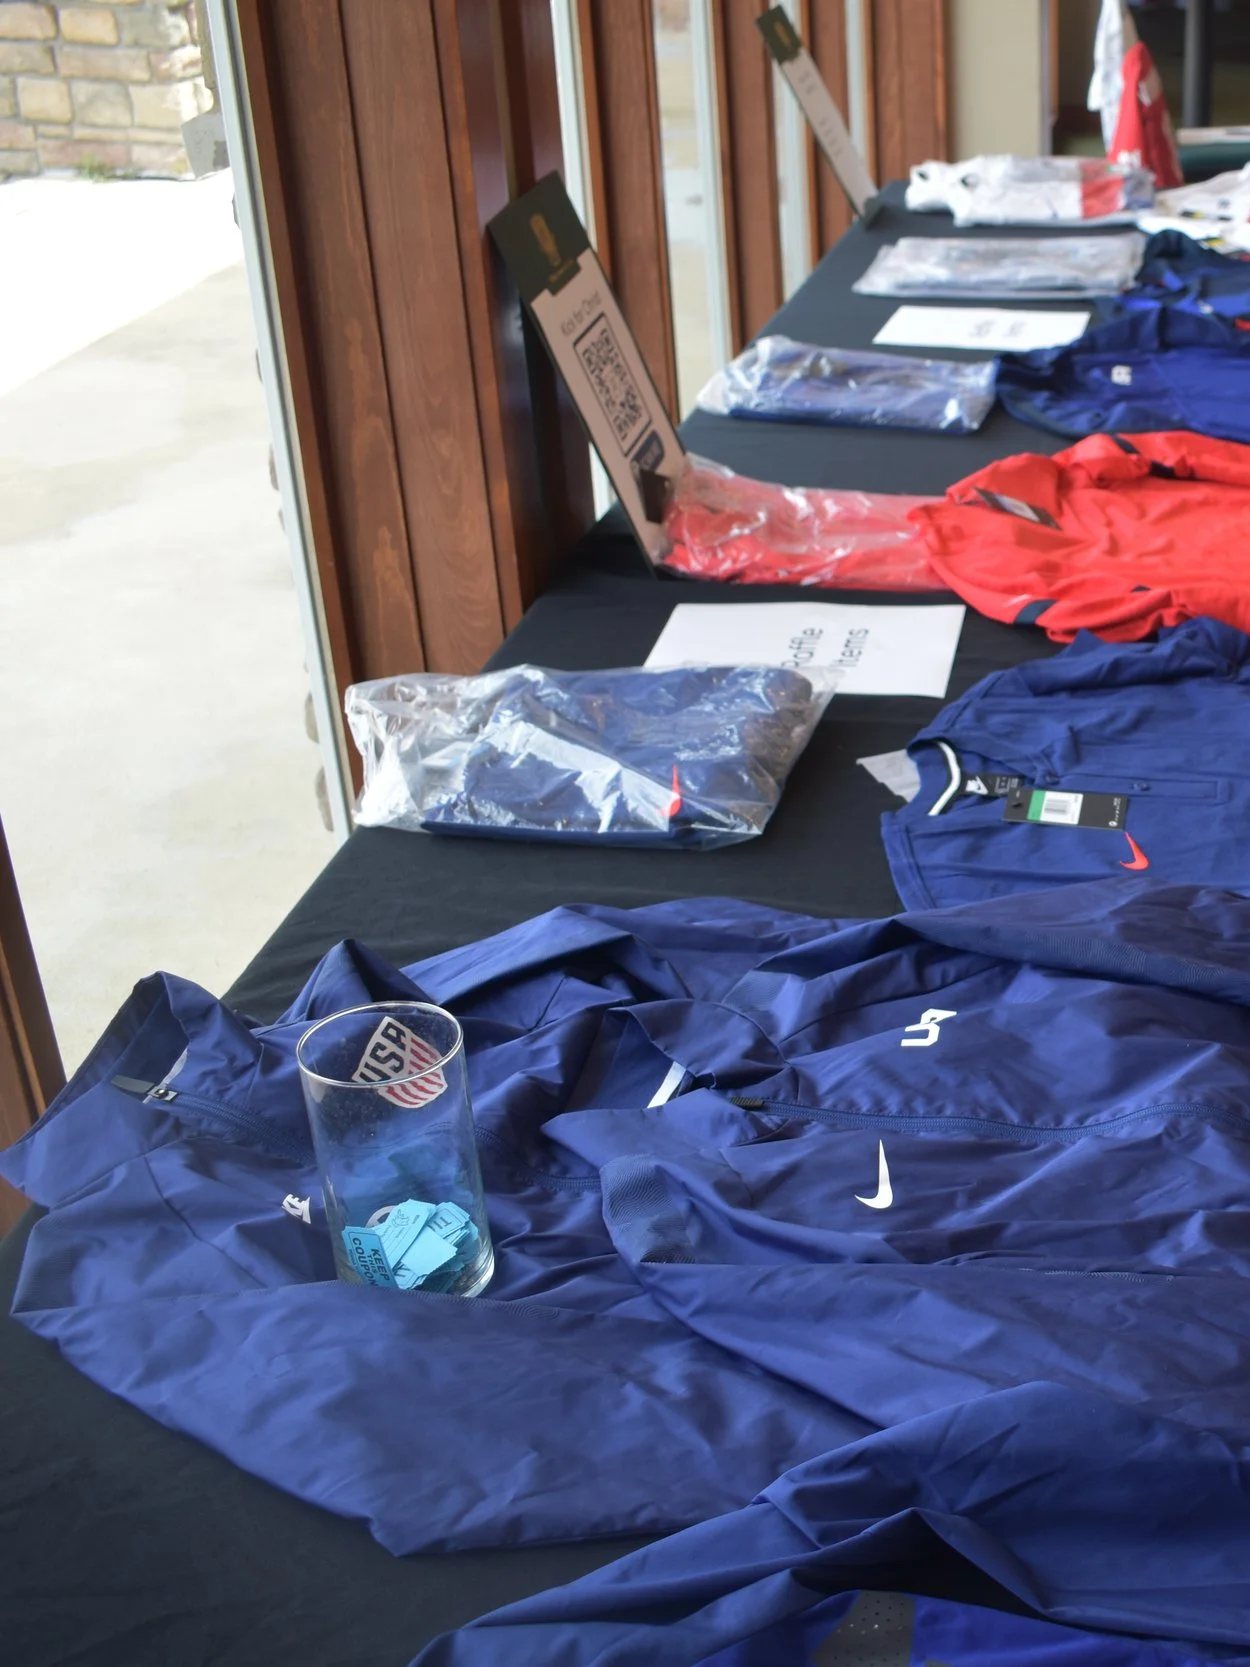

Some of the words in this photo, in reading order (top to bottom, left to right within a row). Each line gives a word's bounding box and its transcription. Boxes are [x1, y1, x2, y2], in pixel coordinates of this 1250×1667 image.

[780, 627, 824, 668] Raffle
[829, 627, 870, 668] Items
[359, 1021, 406, 1082] USA
[352, 1237, 379, 1287] COUPON
[366, 1255, 378, 1274] THIS
[371, 1248, 391, 1281] KEEP
